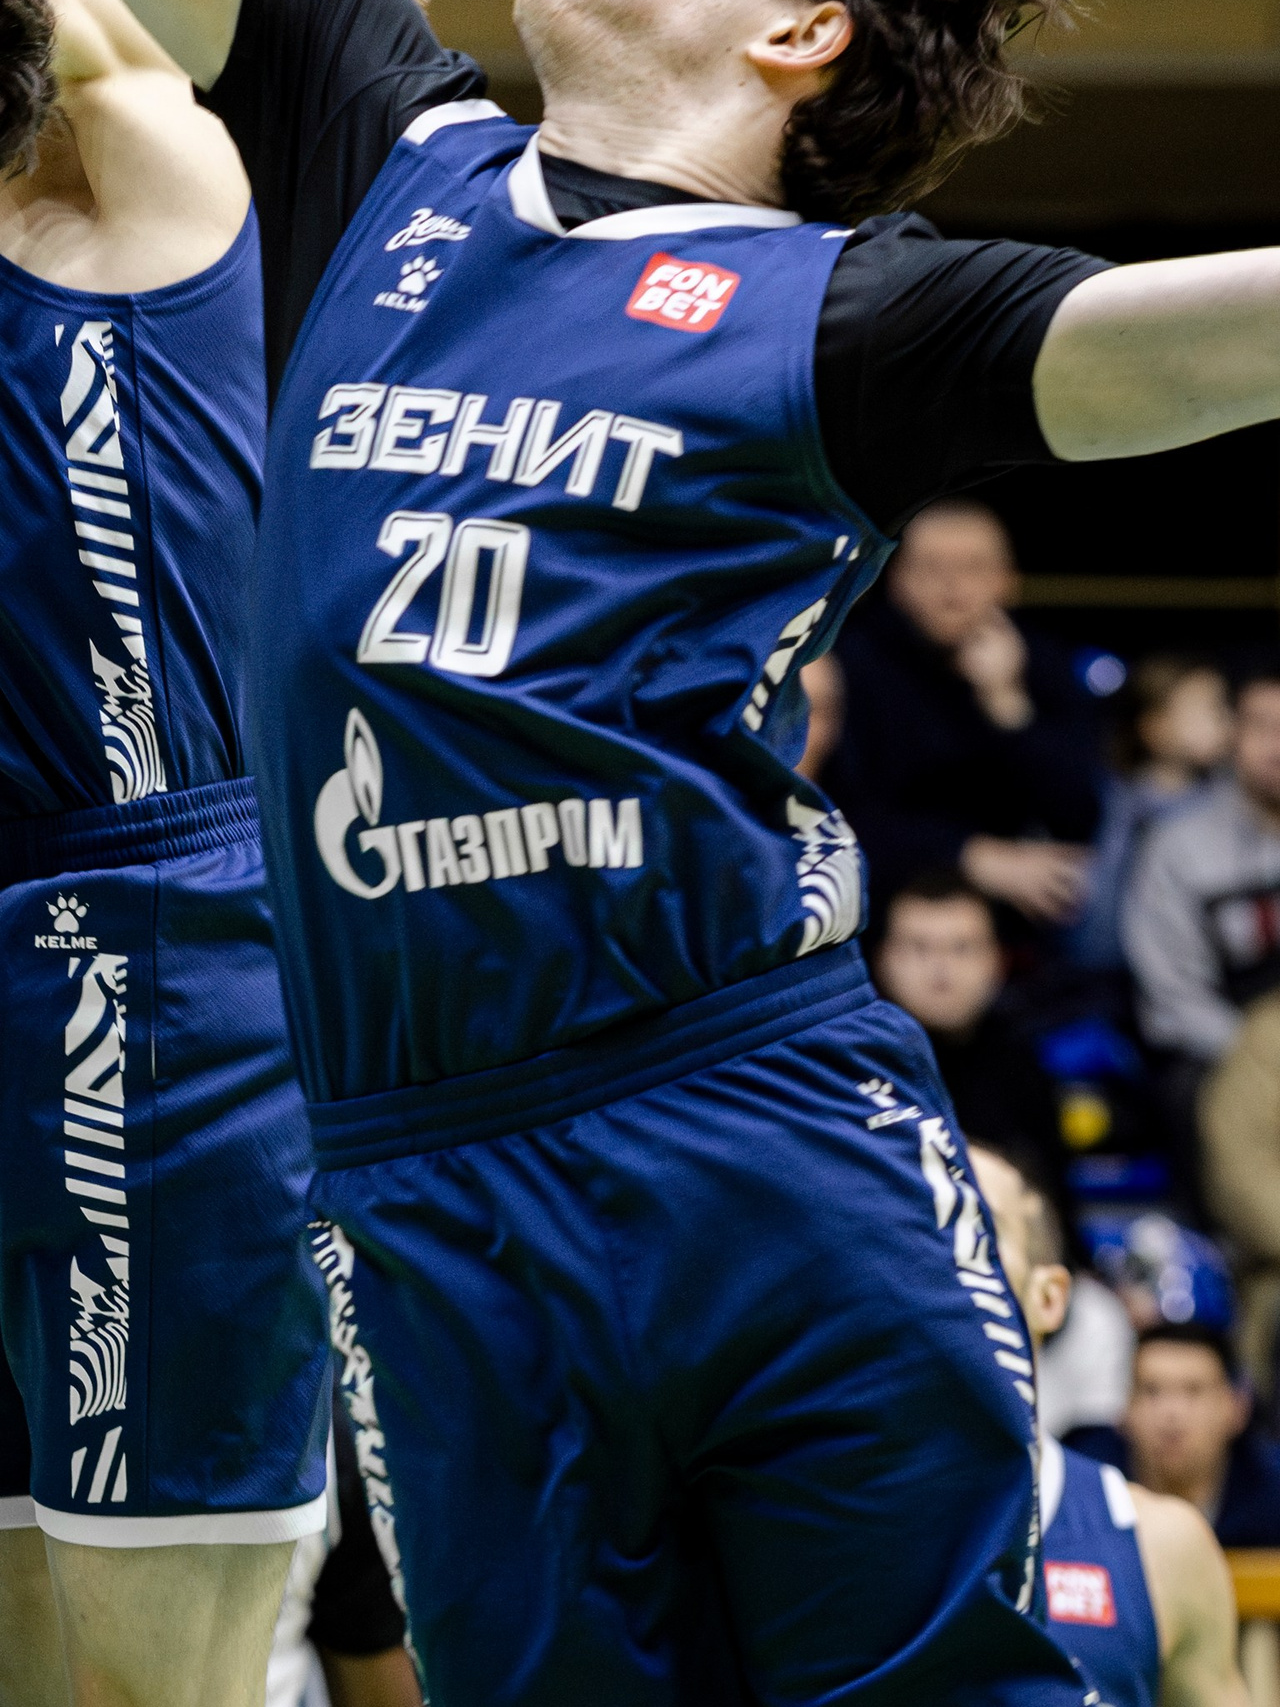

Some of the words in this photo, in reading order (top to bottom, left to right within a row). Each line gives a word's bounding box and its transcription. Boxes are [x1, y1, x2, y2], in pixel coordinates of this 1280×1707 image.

[372, 291, 430, 313] KELM
[645, 264, 735, 302] FON
[632, 285, 724, 324] BET
[310, 382, 684, 512] ЗЕНИТ
[356, 509, 531, 678] 20
[397, 797, 644, 894] ГАЗПРОМ
[34, 934, 98, 950] KELME
